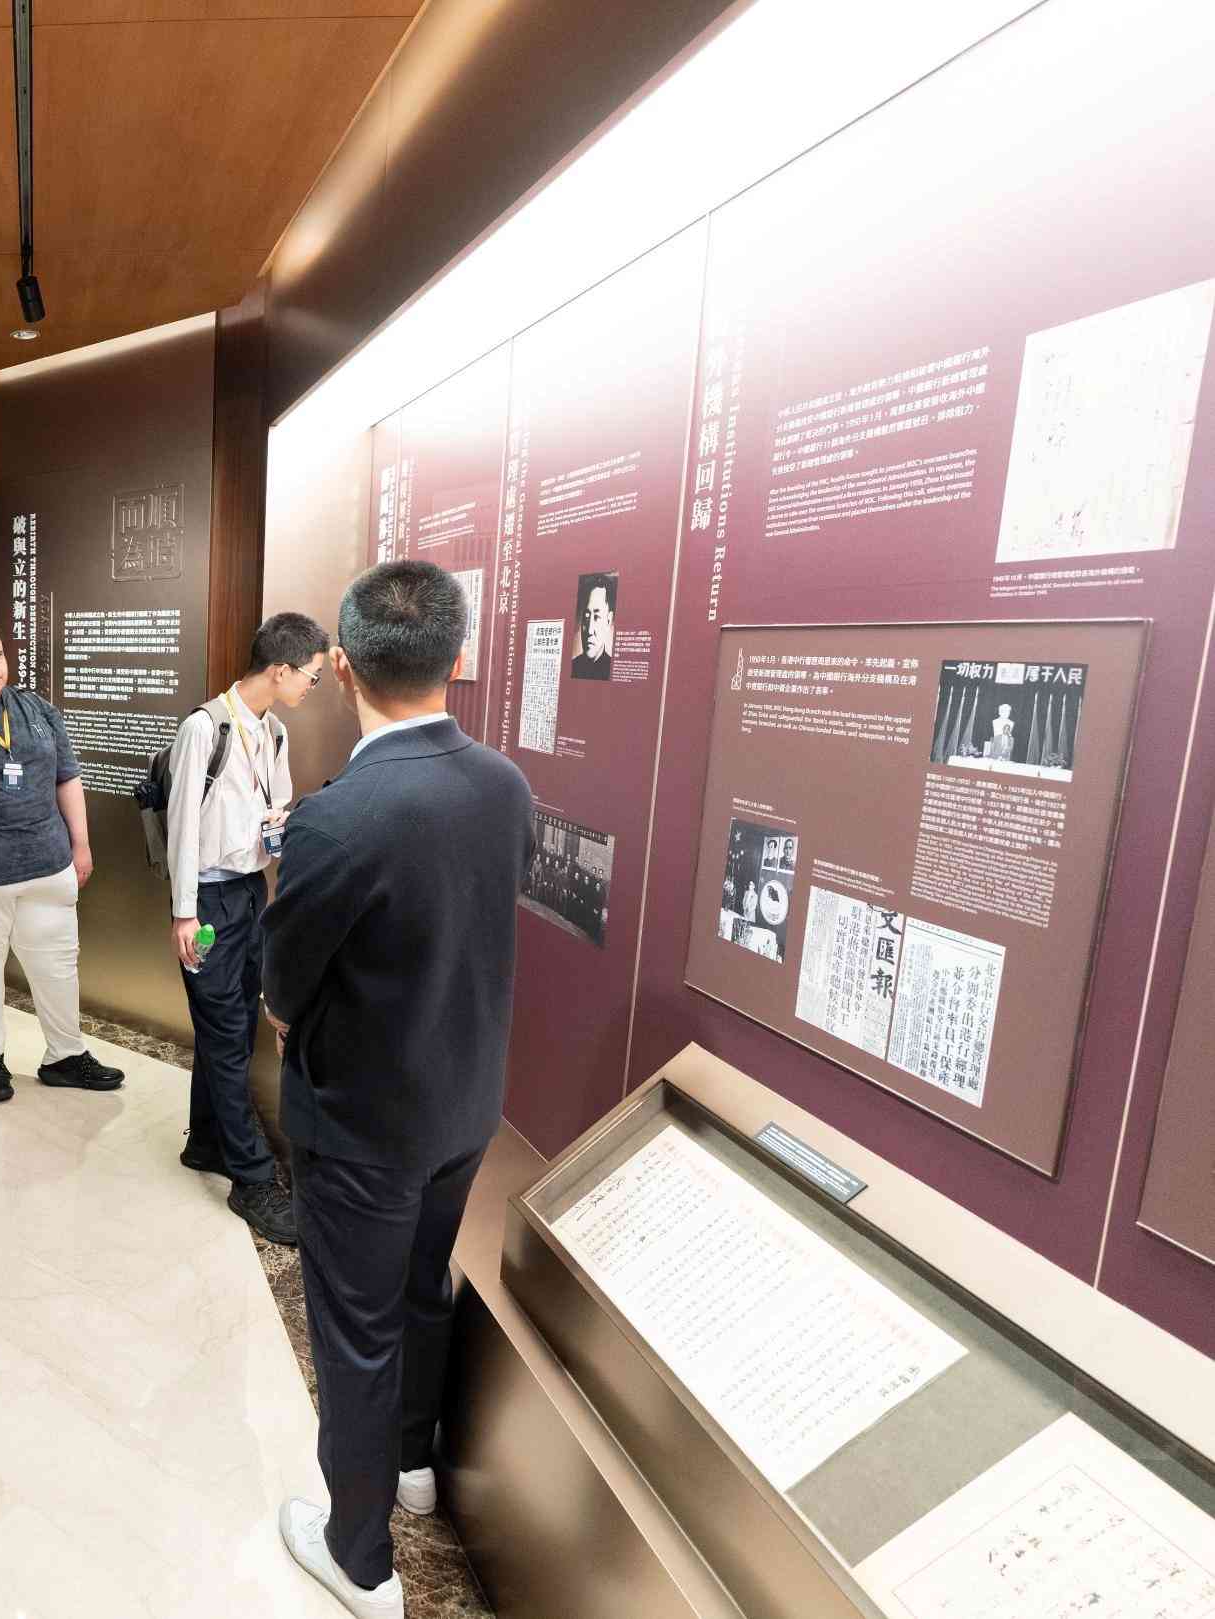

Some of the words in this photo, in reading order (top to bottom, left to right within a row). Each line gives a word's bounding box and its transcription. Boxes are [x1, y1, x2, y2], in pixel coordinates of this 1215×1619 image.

[715, 403, 741, 540] Institutions
[12, 514, 27, 641] 破與立的新生
[505, 558, 523, 676] Administration
[707, 545, 727, 622] Return
[870, 911, 903, 1001] 文匯報
